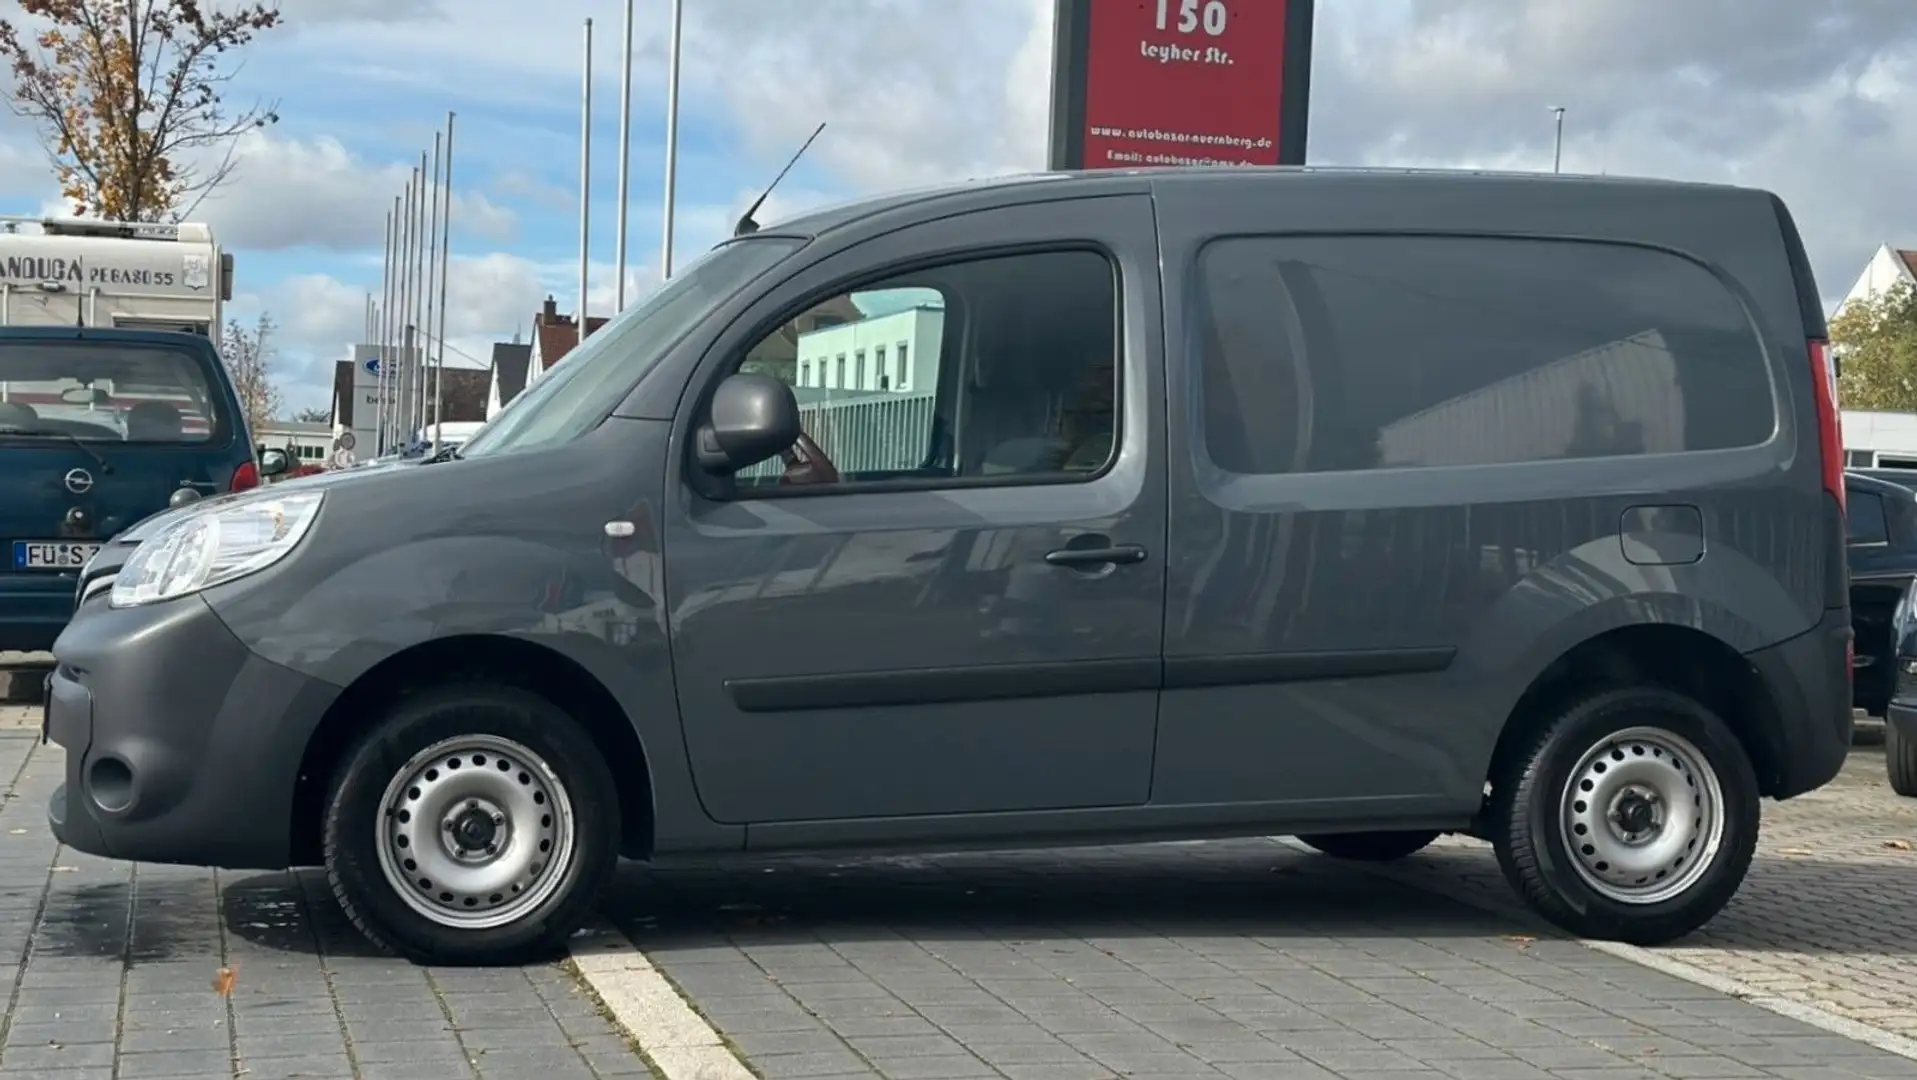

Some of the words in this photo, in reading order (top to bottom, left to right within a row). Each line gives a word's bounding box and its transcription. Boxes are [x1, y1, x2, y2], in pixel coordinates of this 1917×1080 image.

[1155, 0, 1226, 35] 150
[1140, 40, 1200, 63] Leyher
[1205, 47, 1234, 65] Str.
[1107, 150, 1142, 162] Email:
[154, 271, 174, 286] 55
